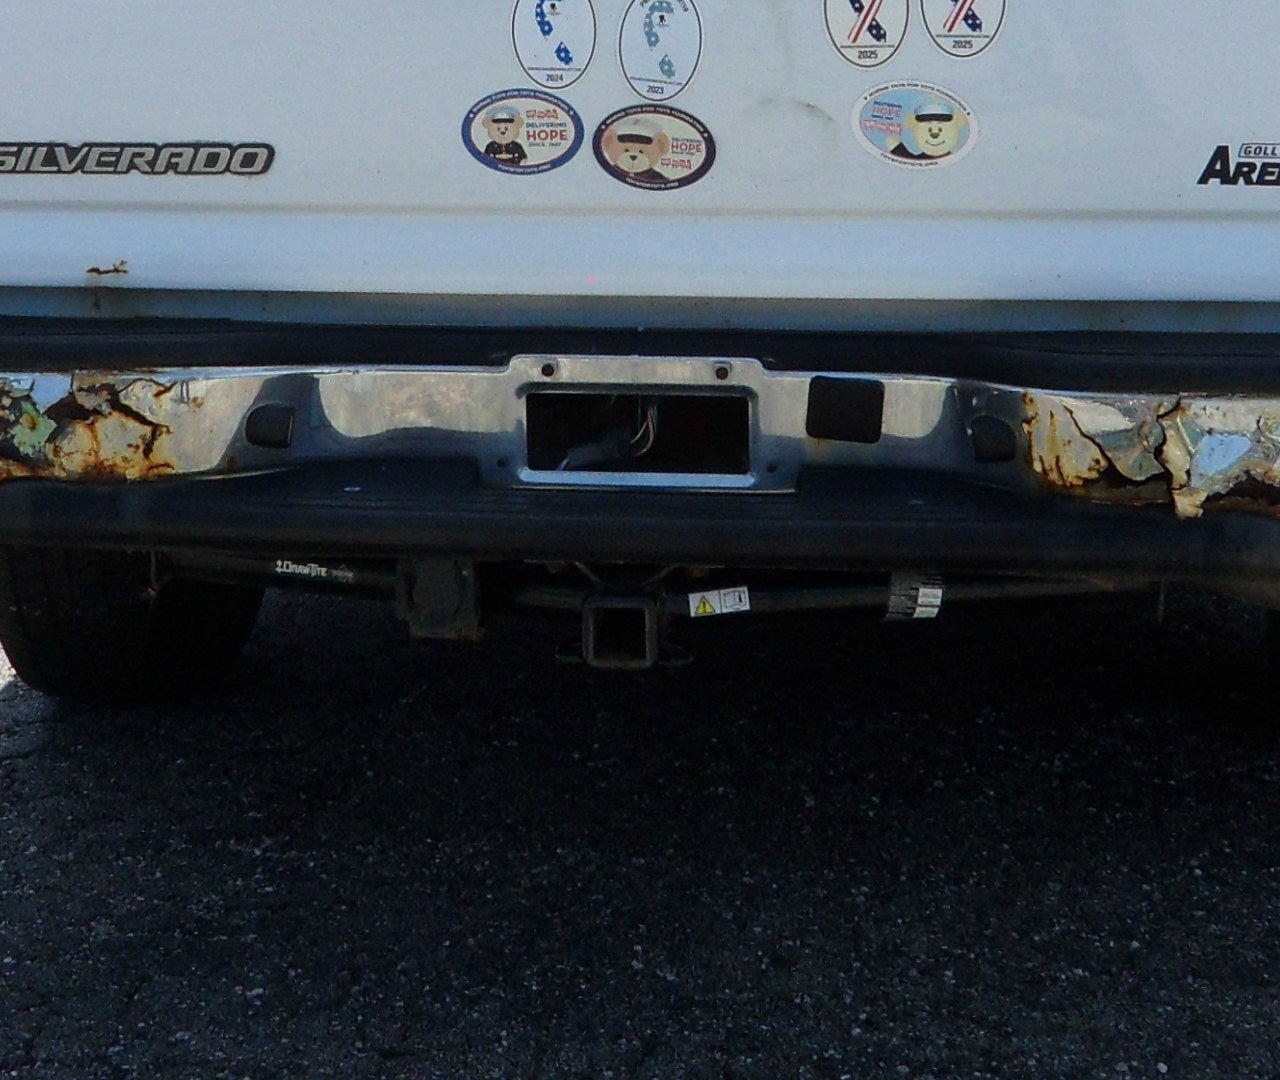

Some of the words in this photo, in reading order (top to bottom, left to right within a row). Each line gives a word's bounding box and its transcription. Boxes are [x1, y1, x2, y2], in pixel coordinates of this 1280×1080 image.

[952, 39, 974, 49] 2025
[857, 50, 878, 59] 2025
[546, 73, 564, 82] 2024
[647, 85, 665, 94] 2023
[872, 106, 902, 117] HOPE
[526, 130, 568, 141] HOPE
[671, 142, 702, 153] HOPE
